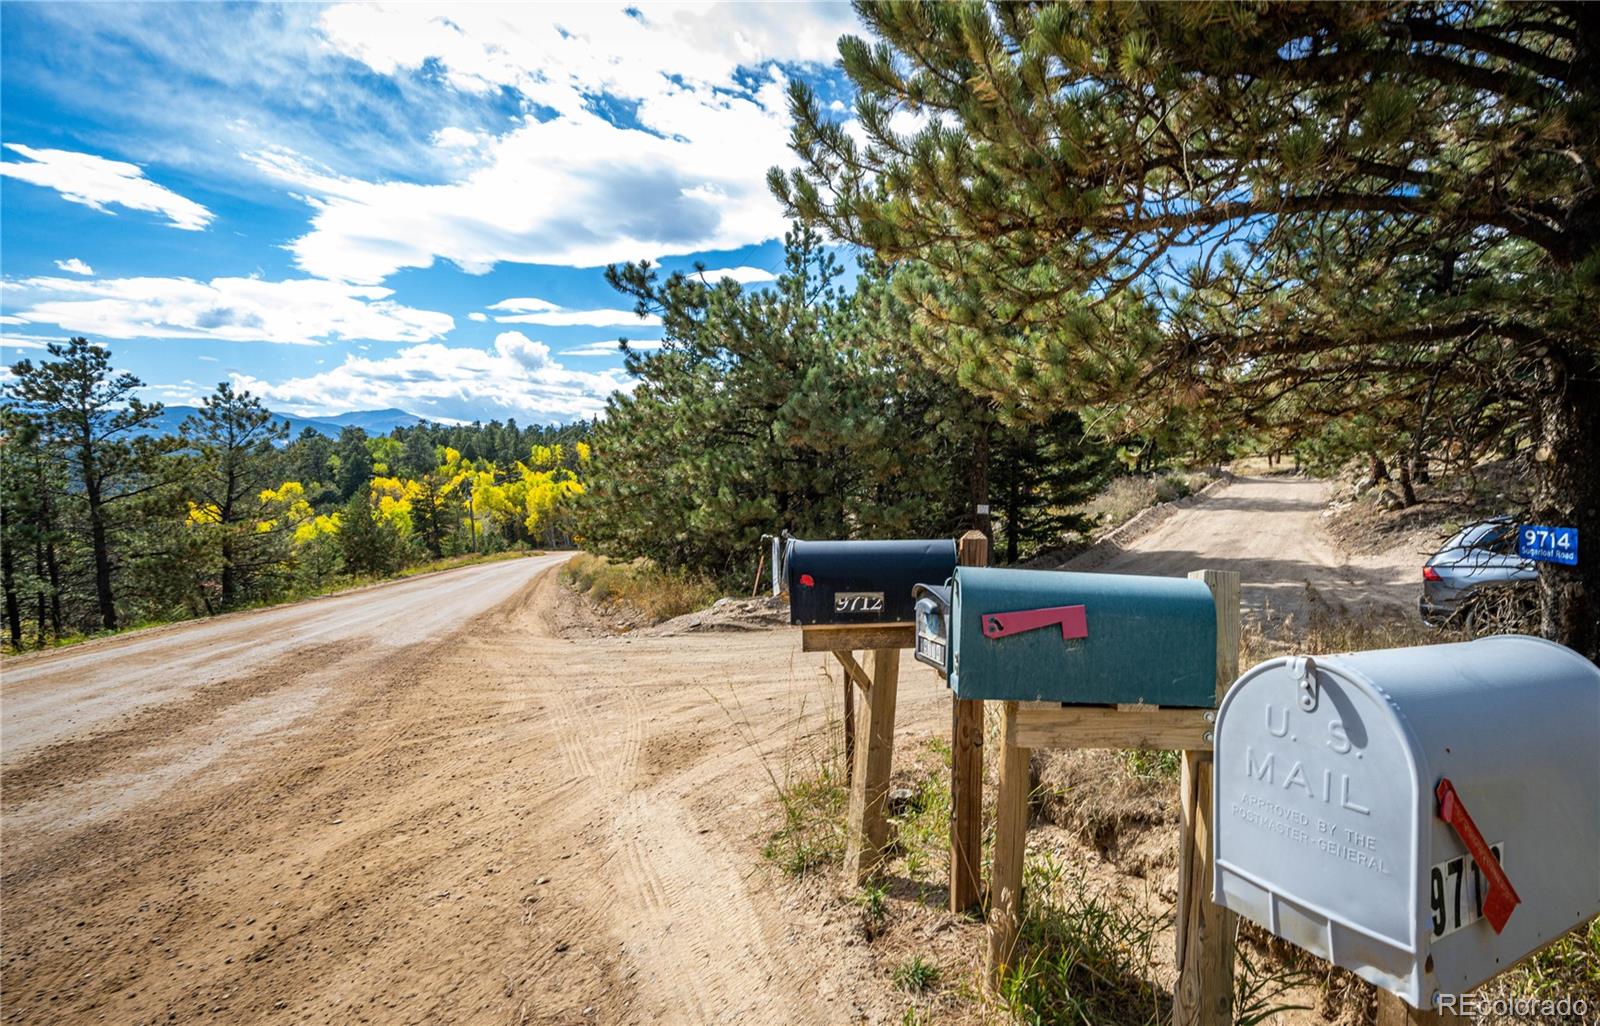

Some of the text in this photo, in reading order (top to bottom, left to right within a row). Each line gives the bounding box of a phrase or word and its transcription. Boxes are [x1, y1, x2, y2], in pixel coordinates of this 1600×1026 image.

[1521, 546, 1575, 561] Sugarloaf Road
[1524, 529, 1570, 550] 9714
[836, 596, 883, 611] 9712
[1246, 745, 1371, 816] MAIL
[1240, 792, 1377, 850] APPROVED BY THE
[1430, 845, 1501, 937] 971
